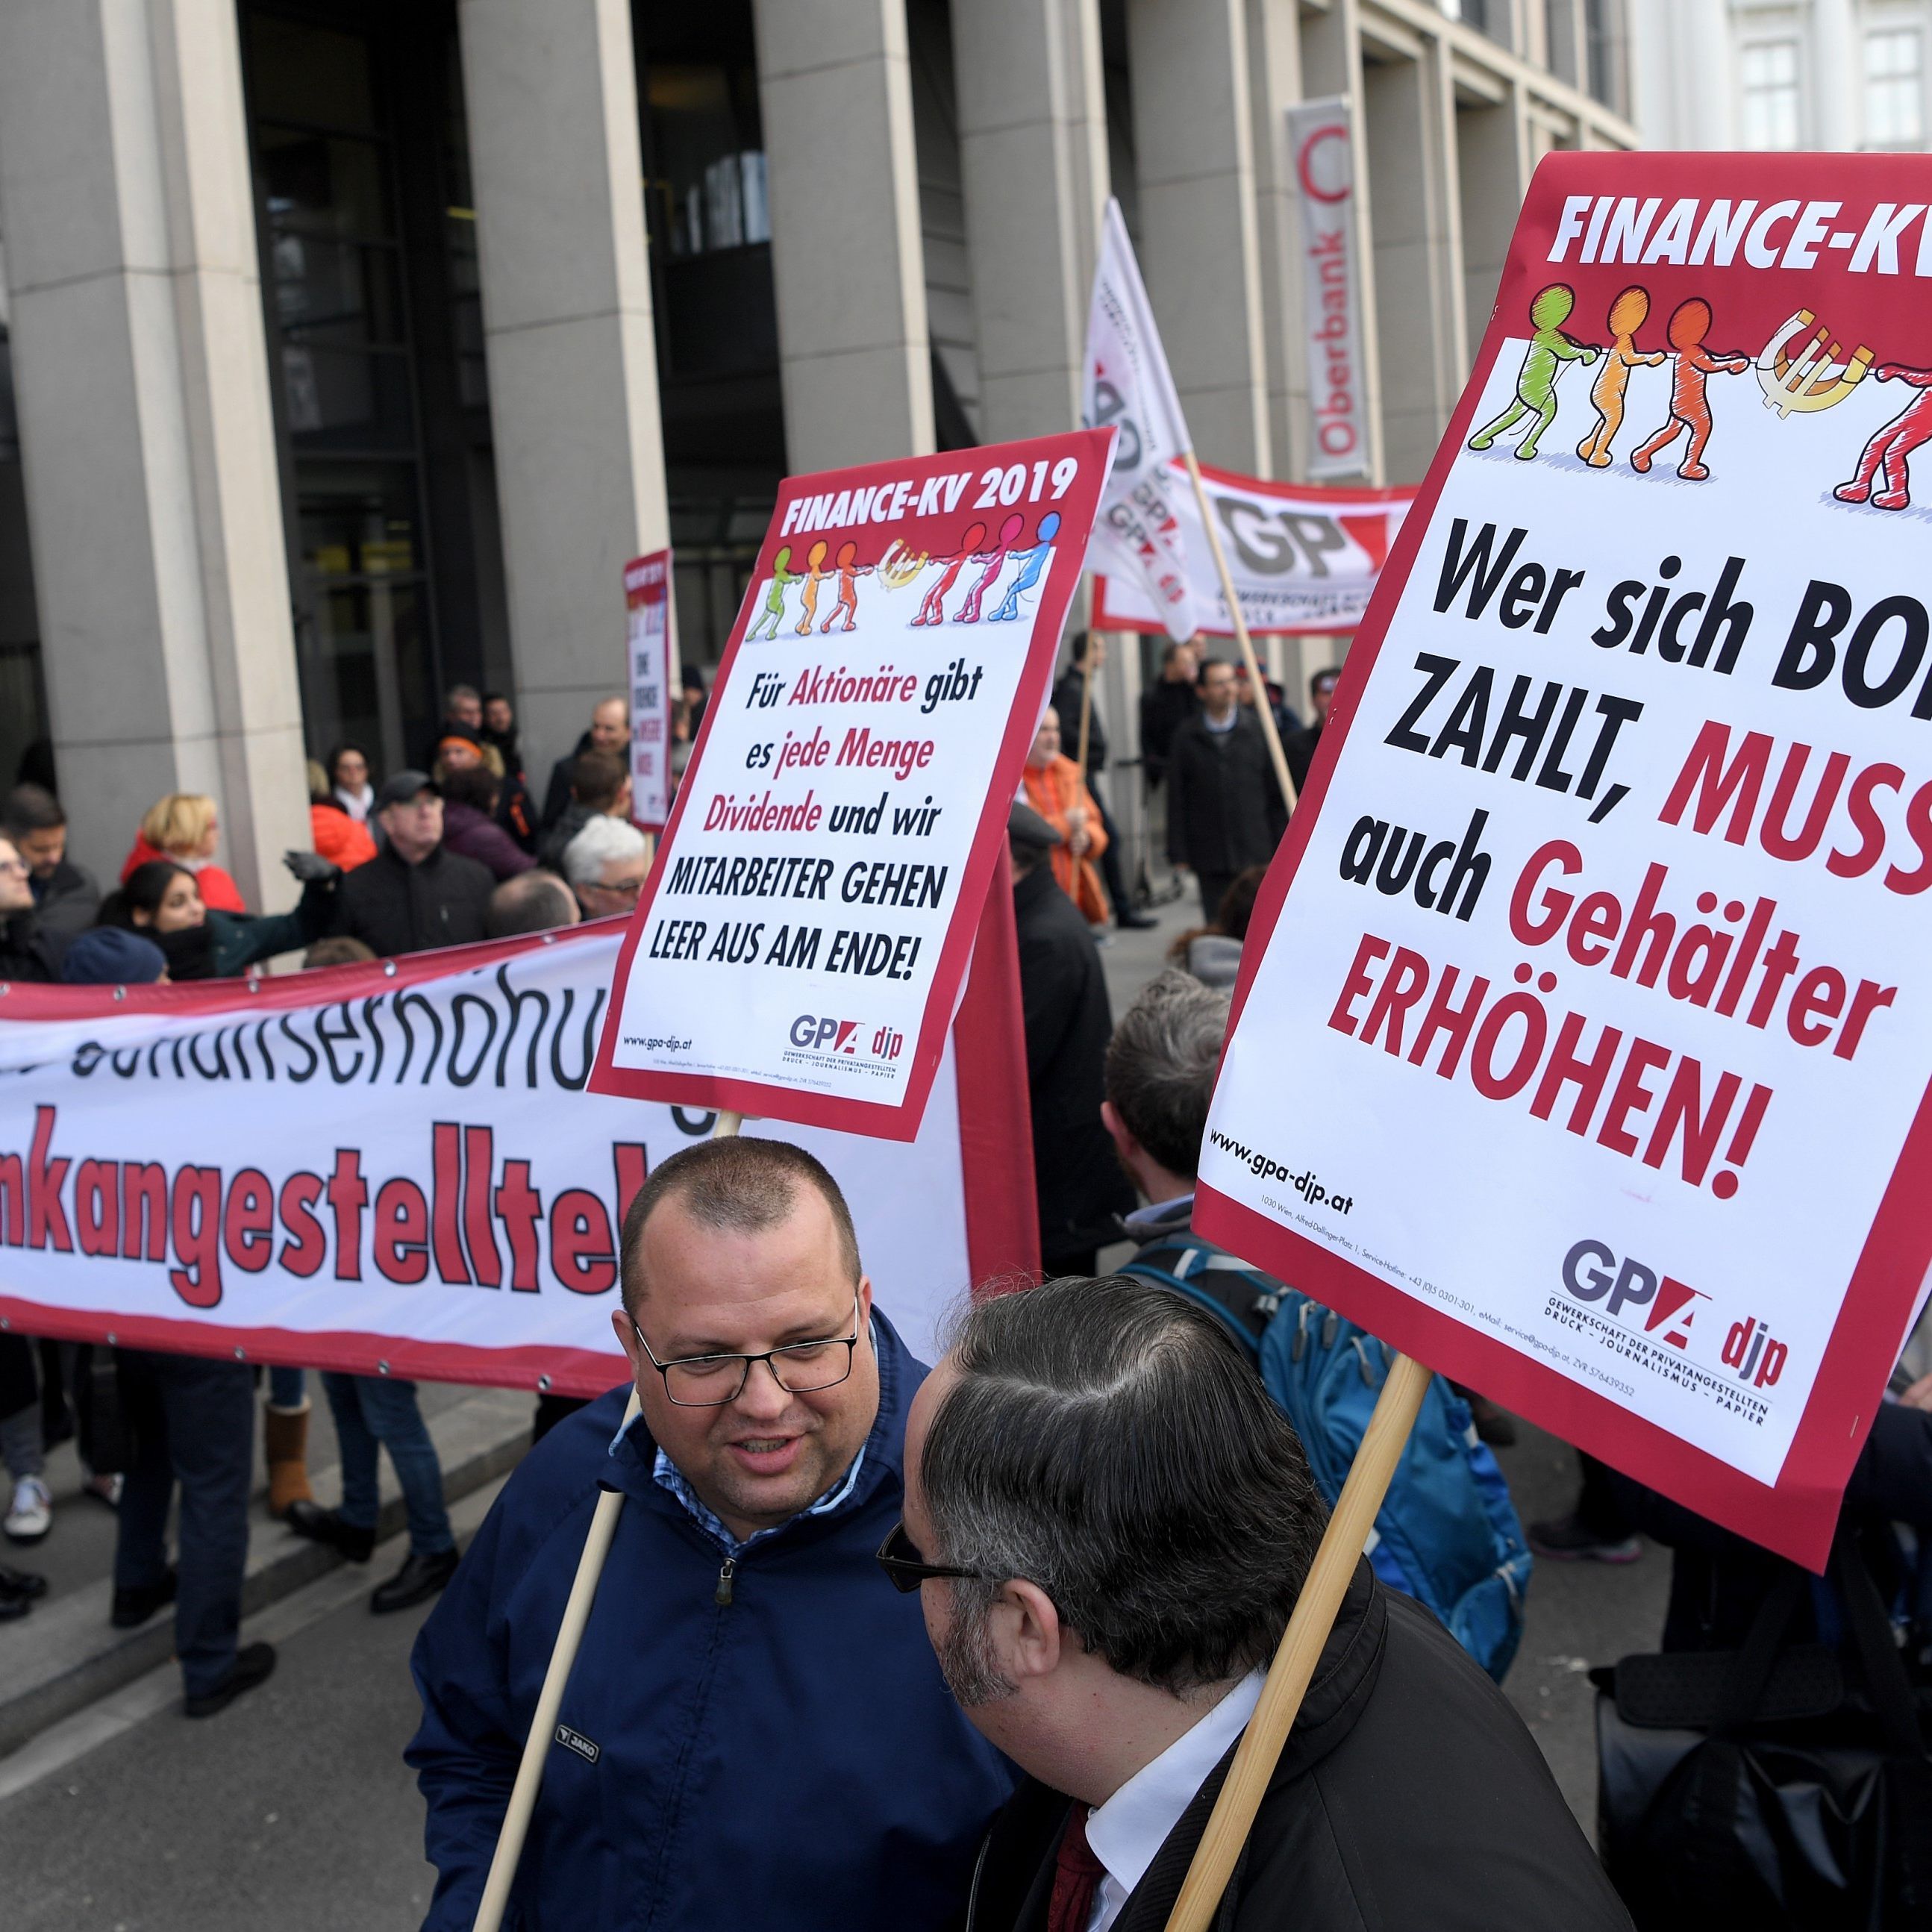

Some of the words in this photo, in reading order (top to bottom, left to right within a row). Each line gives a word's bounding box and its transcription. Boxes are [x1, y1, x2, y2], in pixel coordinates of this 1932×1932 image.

[1310, 230, 1357, 457] Oberbank
[780, 472, 972, 537] FINANCE-KV
[973, 457, 1078, 512] 2019
[1433, 518, 1586, 635] Wer
[1591, 555, 1754, 675] sich
[1771, 579, 1932, 722] BO
[745, 672, 786, 710] Für
[788, 663, 918, 707] Aktionäre
[920, 658, 983, 713] gibt
[745, 741, 773, 769] es
[772, 725, 831, 780] jede
[835, 728, 934, 781] Menge
[1384, 652, 1645, 824] ZAHLT,
[703, 790, 822, 831] Dividende
[828, 792, 889, 836] und
[892, 795, 942, 837] wir
[666, 856, 834, 901] MITARBEITER
[841, 861, 948, 909] GEHEN
[648, 919, 707, 960] LEER
[707, 922, 765, 964] AUS
[765, 925, 822, 970] AM
[825, 930, 922, 981] ENDE!
[1339, 808, 1492, 922] auch
[1508, 839, 1898, 1061] Gehälter
[623, 1034, 693, 1053] www.gpa-djp.at
[782, 1057, 803, 1065] DRUCK
[810, 1060, 863, 1075] JOURNALISMUS
[871, 1070, 895, 1079] PAPIER
[872, 1025, 904, 1060] djp
[1327, 933, 1774, 1200] ERHÖHEN!
[1209, 1128, 1354, 1215] www.gpa-djp.at
[1260, 1194, 1278, 1209] 1030
[1543, 1306, 1584, 1334] DRUCK
[1598, 1335, 1698, 1393] JOURNALISMUS
[1715, 1395, 1766, 1428] PAPIER
[1547, 1296, 1628, 1344] GEWERKSCHAFT
[1628, 1337, 1650, 1356] DER
[1649, 1349, 1769, 1416] PRIVATANGESTELLTEN
[1721, 1315, 1789, 1388] djp
[571, 1736, 595, 1757] JAKO
